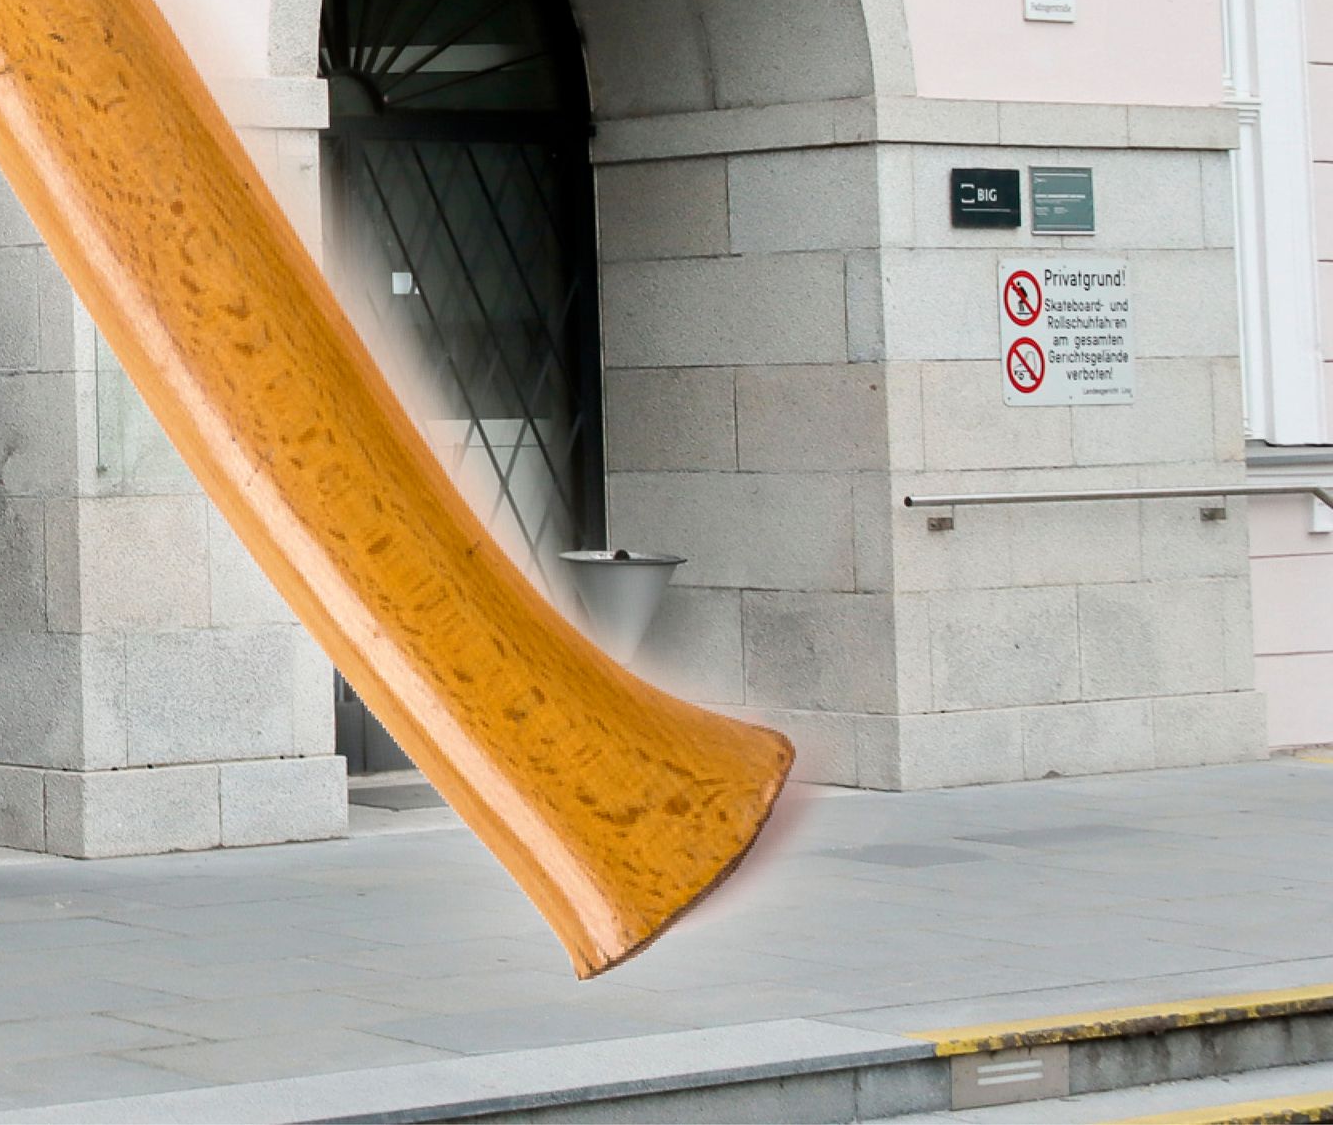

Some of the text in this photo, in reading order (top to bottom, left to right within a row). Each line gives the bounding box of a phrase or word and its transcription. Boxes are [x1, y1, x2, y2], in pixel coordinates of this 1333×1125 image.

[977, 188, 998, 202] BIG
[1044, 269, 1126, 291] Privatgrund!
[1044, 298, 1128, 312] Skateboard- und
[1053, 335, 1124, 349] am gesamten
[1048, 350, 1129, 366] Gerichtsgelände
[1066, 368, 1113, 381] verboten!
